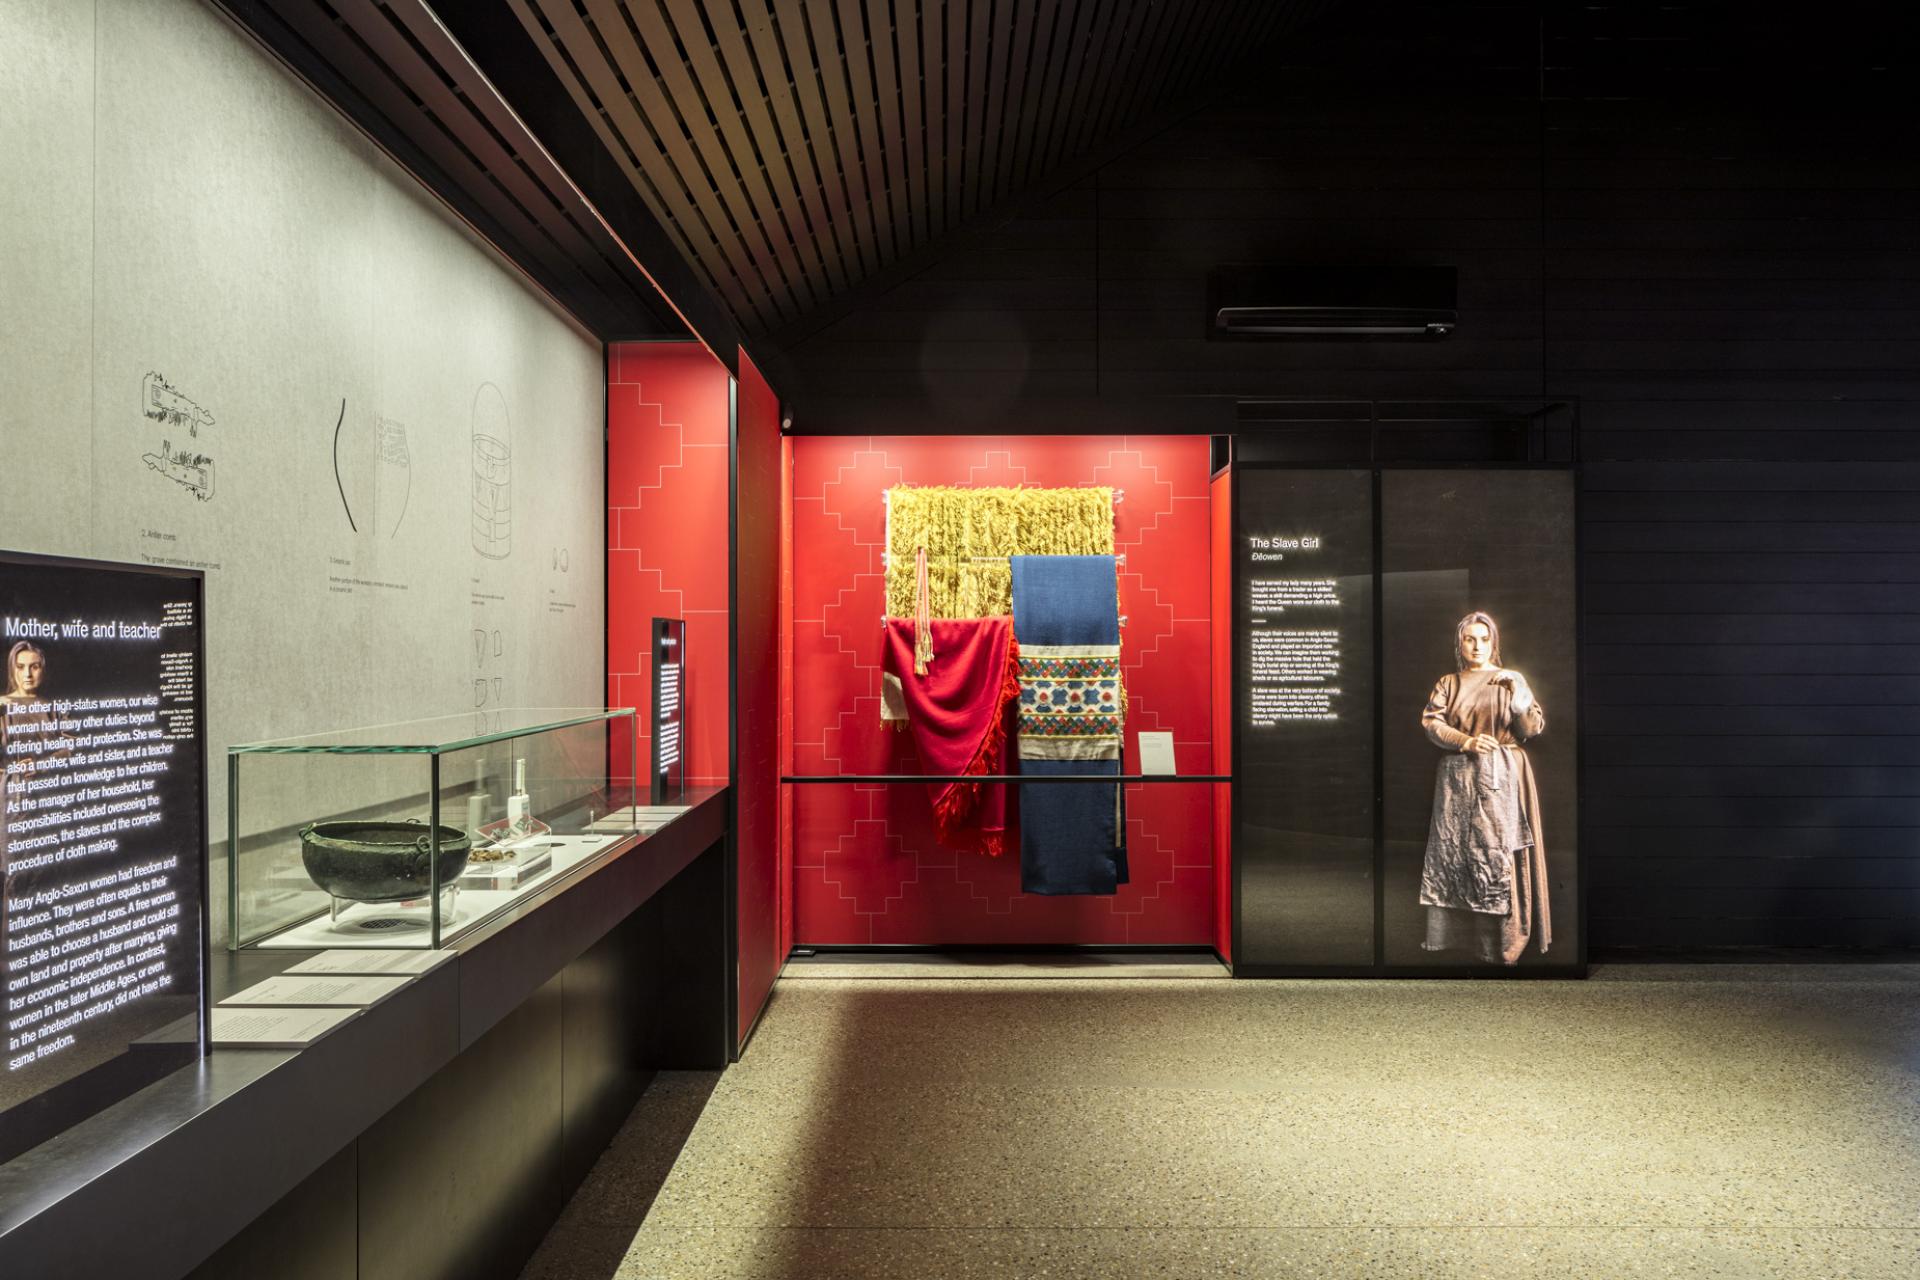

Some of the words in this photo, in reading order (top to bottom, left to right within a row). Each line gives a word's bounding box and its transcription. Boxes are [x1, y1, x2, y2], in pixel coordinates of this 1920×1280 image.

[1250, 538, 1270, 548] The
[1272, 538, 1299, 549] Slave
[1301, 538, 1319, 548] Girl
[6, 617, 58, 640] Mother,
[62, 620, 89, 637] wife
[93, 621, 115, 637] and
[119, 622, 161, 638] teacher
[7, 702, 26, 715] Like
[29, 701, 51, 713] other
[53, 699, 98, 713] high-status
[100, 699, 128, 710] women,
[130, 698, 140, 707] our
[142, 695, 158, 706] wise
[8, 723, 39, 734] woman
[41, 719, 57, 731] had
[60, 720, 81, 731] many
[83, 716, 103, 728] other
[105, 714, 128, 725] duties
[130, 711, 154, 725] beyond
[8, 740, 41, 755] offering
[44, 736, 74, 750] healing
[76, 734, 91, 746] and
[93, 731, 132, 747] protection.
[133, 729, 147, 740] She
[148, 730, 161, 740] was
[8, 761, 26, 774] also
[29, 763, 35, 772] a
[37, 755, 67, 770] mother,
[70, 752, 86, 765] wife
[88, 750, 103, 763] and
[105, 748, 125, 762] sister,
[127, 746, 140, 758] and
[142, 748, 147, 757] a
[148, 743, 173, 756] teacher
[7, 800, 20, 814] As
[22, 798, 36, 811] the
[38, 792, 75, 809] manager
[77, 788, 86, 802] of
[88, 787, 100, 800] her
[102, 781, 141, 797] household,
[142, 779, 154, 791] her
[8, 781, 26, 794] that
[28, 775, 59, 793] passed
[61, 775, 72, 786] on
[74, 768, 115, 784] knowledge
[117, 766, 125, 777] to
[126, 764, 138, 776] her
[140, 761, 168, 774] children.
[8, 811, 72, 834] responsibilities
[73, 803, 106, 821] included
[108, 797, 147, 815] overseeing
[148, 795, 159, 807] the
[8, 833, 60, 854] storerooms,
[61, 828, 75, 842] the
[77, 822, 101, 839] slaves
[103, 820, 116, 833] and
[118, 817, 130, 830] the
[132, 811, 161, 827] complex
[9, 853, 53, 876] procedure
[56, 848, 65, 862] of
[67, 844, 86, 859] cloth
[88, 838, 118, 856] making.
[9, 896, 33, 912] Many
[35, 882, 88, 907] Anglo-Saxon
[90, 873, 117, 890] women
[118, 867, 132, 882] had
[134, 861, 162, 877] freedom
[163, 855, 177, 870] and
[9, 911, 52, 932] influence.
[53, 903, 73, 918] They
[75, 898, 95, 913] were
[96, 891, 117, 908] often
[118, 883, 142, 902] equals
[143, 880, 150, 892] to
[151, 875, 167, 889] their
[10, 928, 54, 952] husbands,
[56, 917, 90, 937] brothers
[91, 910, 106, 926] and
[108, 907, 128, 921] sons.
[128, 901, 135, 914] A
[136, 896, 151, 911] free
[152, 891, 176, 907] woman
[9, 956, 28, 971] was
[30, 949, 49, 966] able
[51, 944, 60, 957] to
[62, 934, 91, 954] choose
[92, 932, 98, 943] a
[99, 921, 131, 941] husband
[132, 916, 146, 930] and
[148, 908, 166, 925] could
[167, 903, 179, 918] still
[10, 976, 29, 991] own
[31, 965, 50, 984] land
[52, 959, 68, 976] and
[70, 948, 104, 973] property
[105, 941, 123, 957] after
[124, 932, 156, 950] marrying,
[157, 922, 177, 940] giving
[10, 996, 26, 1011] her
[28, 979, 69, 1004] economic
[71, 959, 126, 988] independence.
[128, 954, 135, 966] In
[136, 942, 166, 962] contrast,
[10, 1008, 43, 1031] women
[44, 1003, 53, 1017] in
[55, 997, 69, 1013] the
[70, 989, 89, 1007] later
[90, 979, 116, 999] Middle
[118, 972, 138, 989] Ages,
[139, 968, 147, 979] or
[148, 961, 165, 976] even
[10, 1036, 20, 1051] in
[21, 1029, 37, 1046] the
[39, 1010, 82, 1039] nineteenth
[84, 998, 114, 1020] century,
[115, 990, 128, 1006] did
[129, 985, 141, 1001] not
[142, 977, 159, 995] have
[160, 974, 172, 989] the
[10, 1051, 36, 1071] same
[38, 1034, 76, 1058] freedom.
